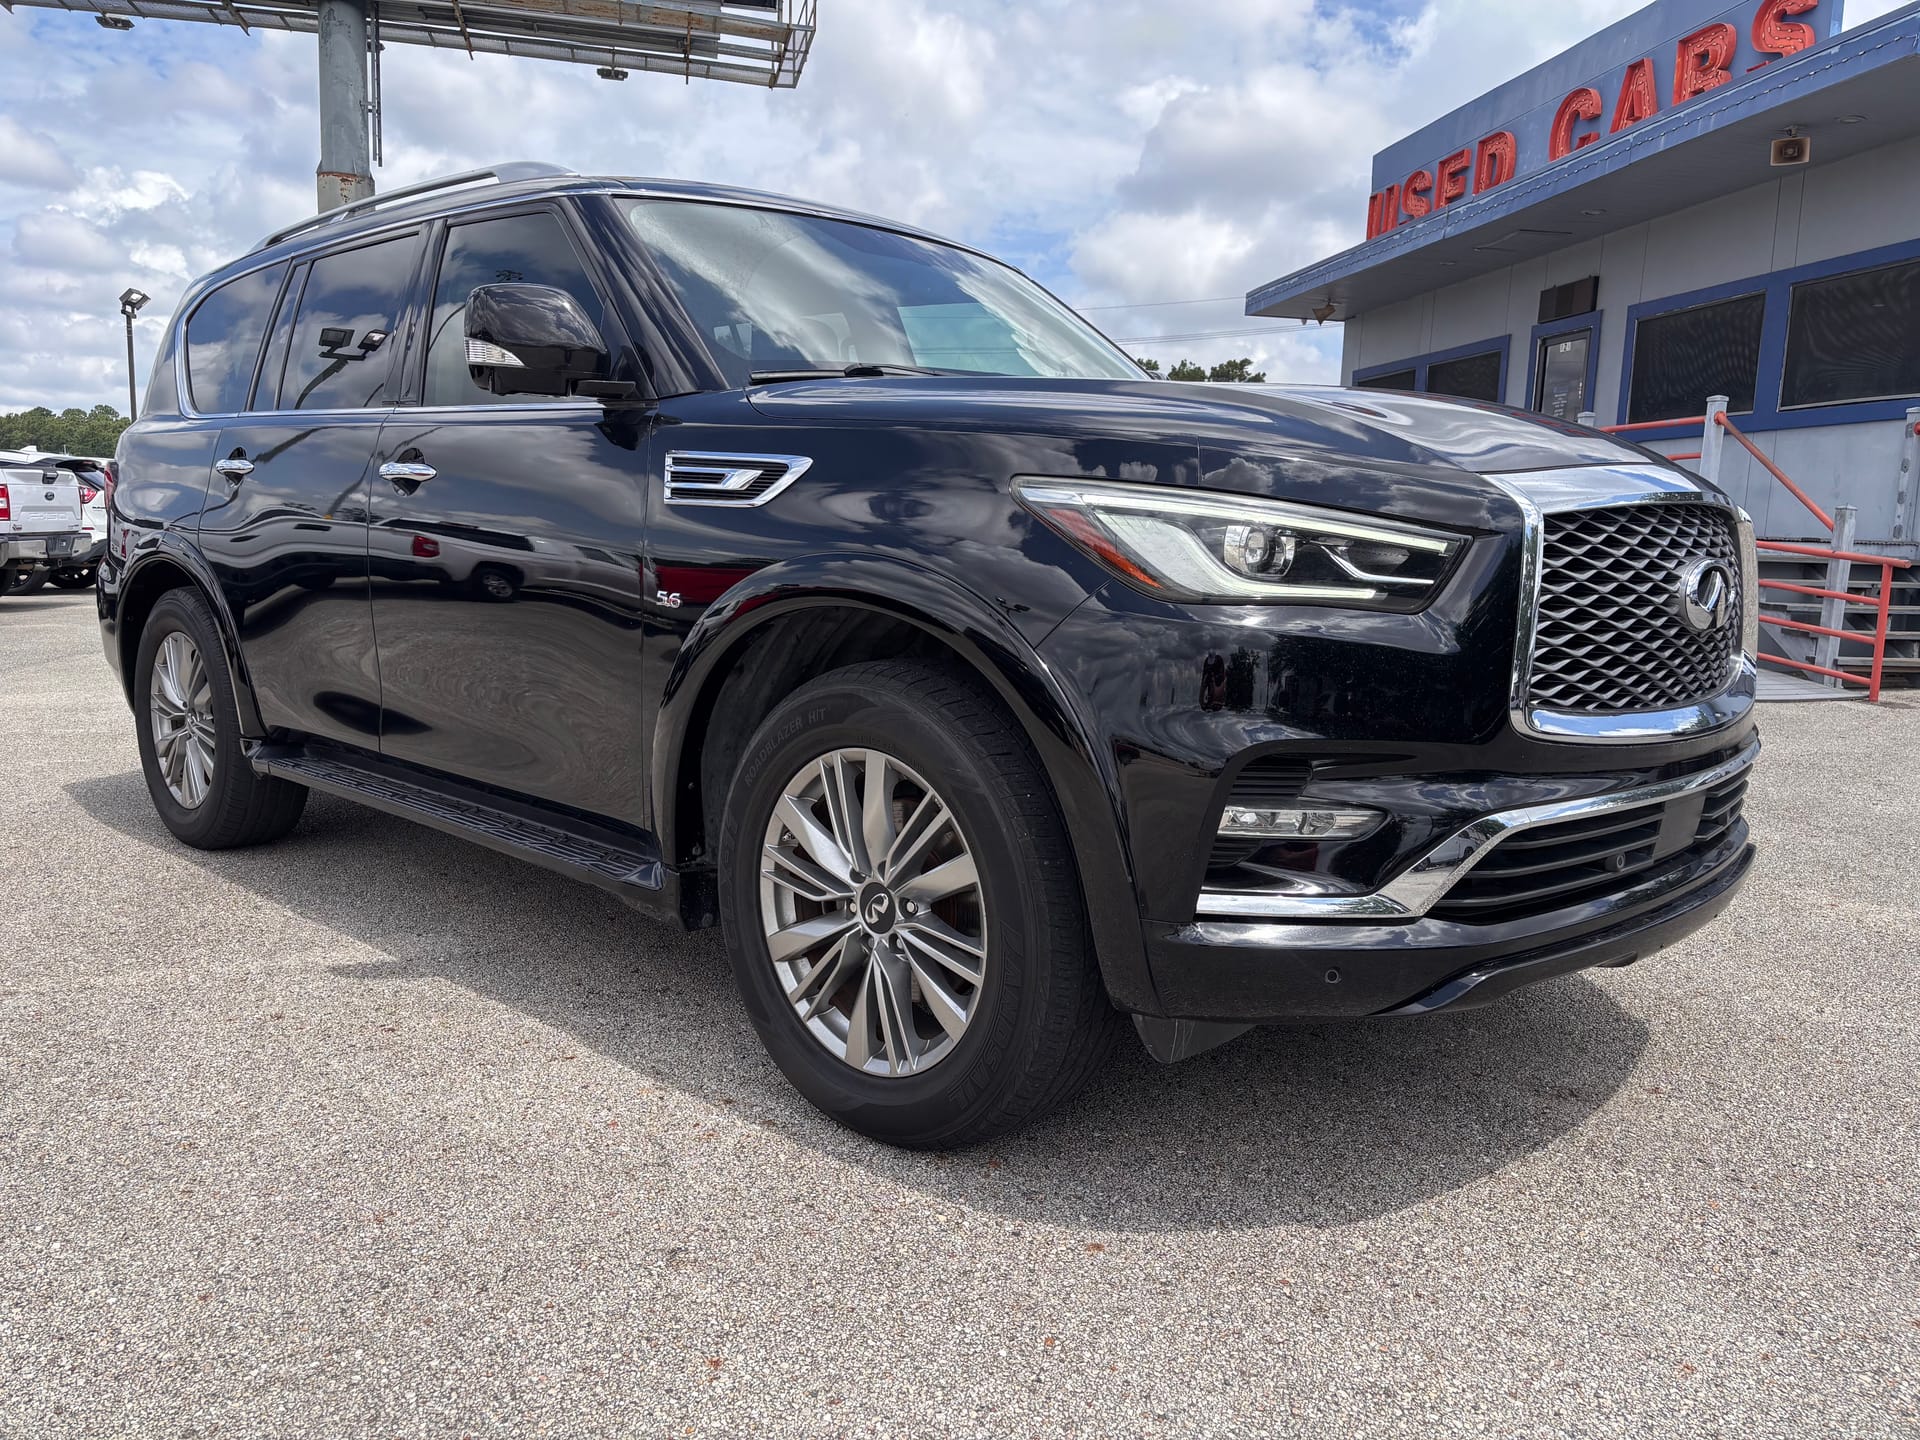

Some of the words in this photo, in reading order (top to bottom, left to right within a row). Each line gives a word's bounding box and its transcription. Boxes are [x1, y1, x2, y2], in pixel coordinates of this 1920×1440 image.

[1366, 131, 1517, 240] USED
[1549, 0, 1818, 162] CARS
[743, 717, 803, 787] ROADBLAZER
